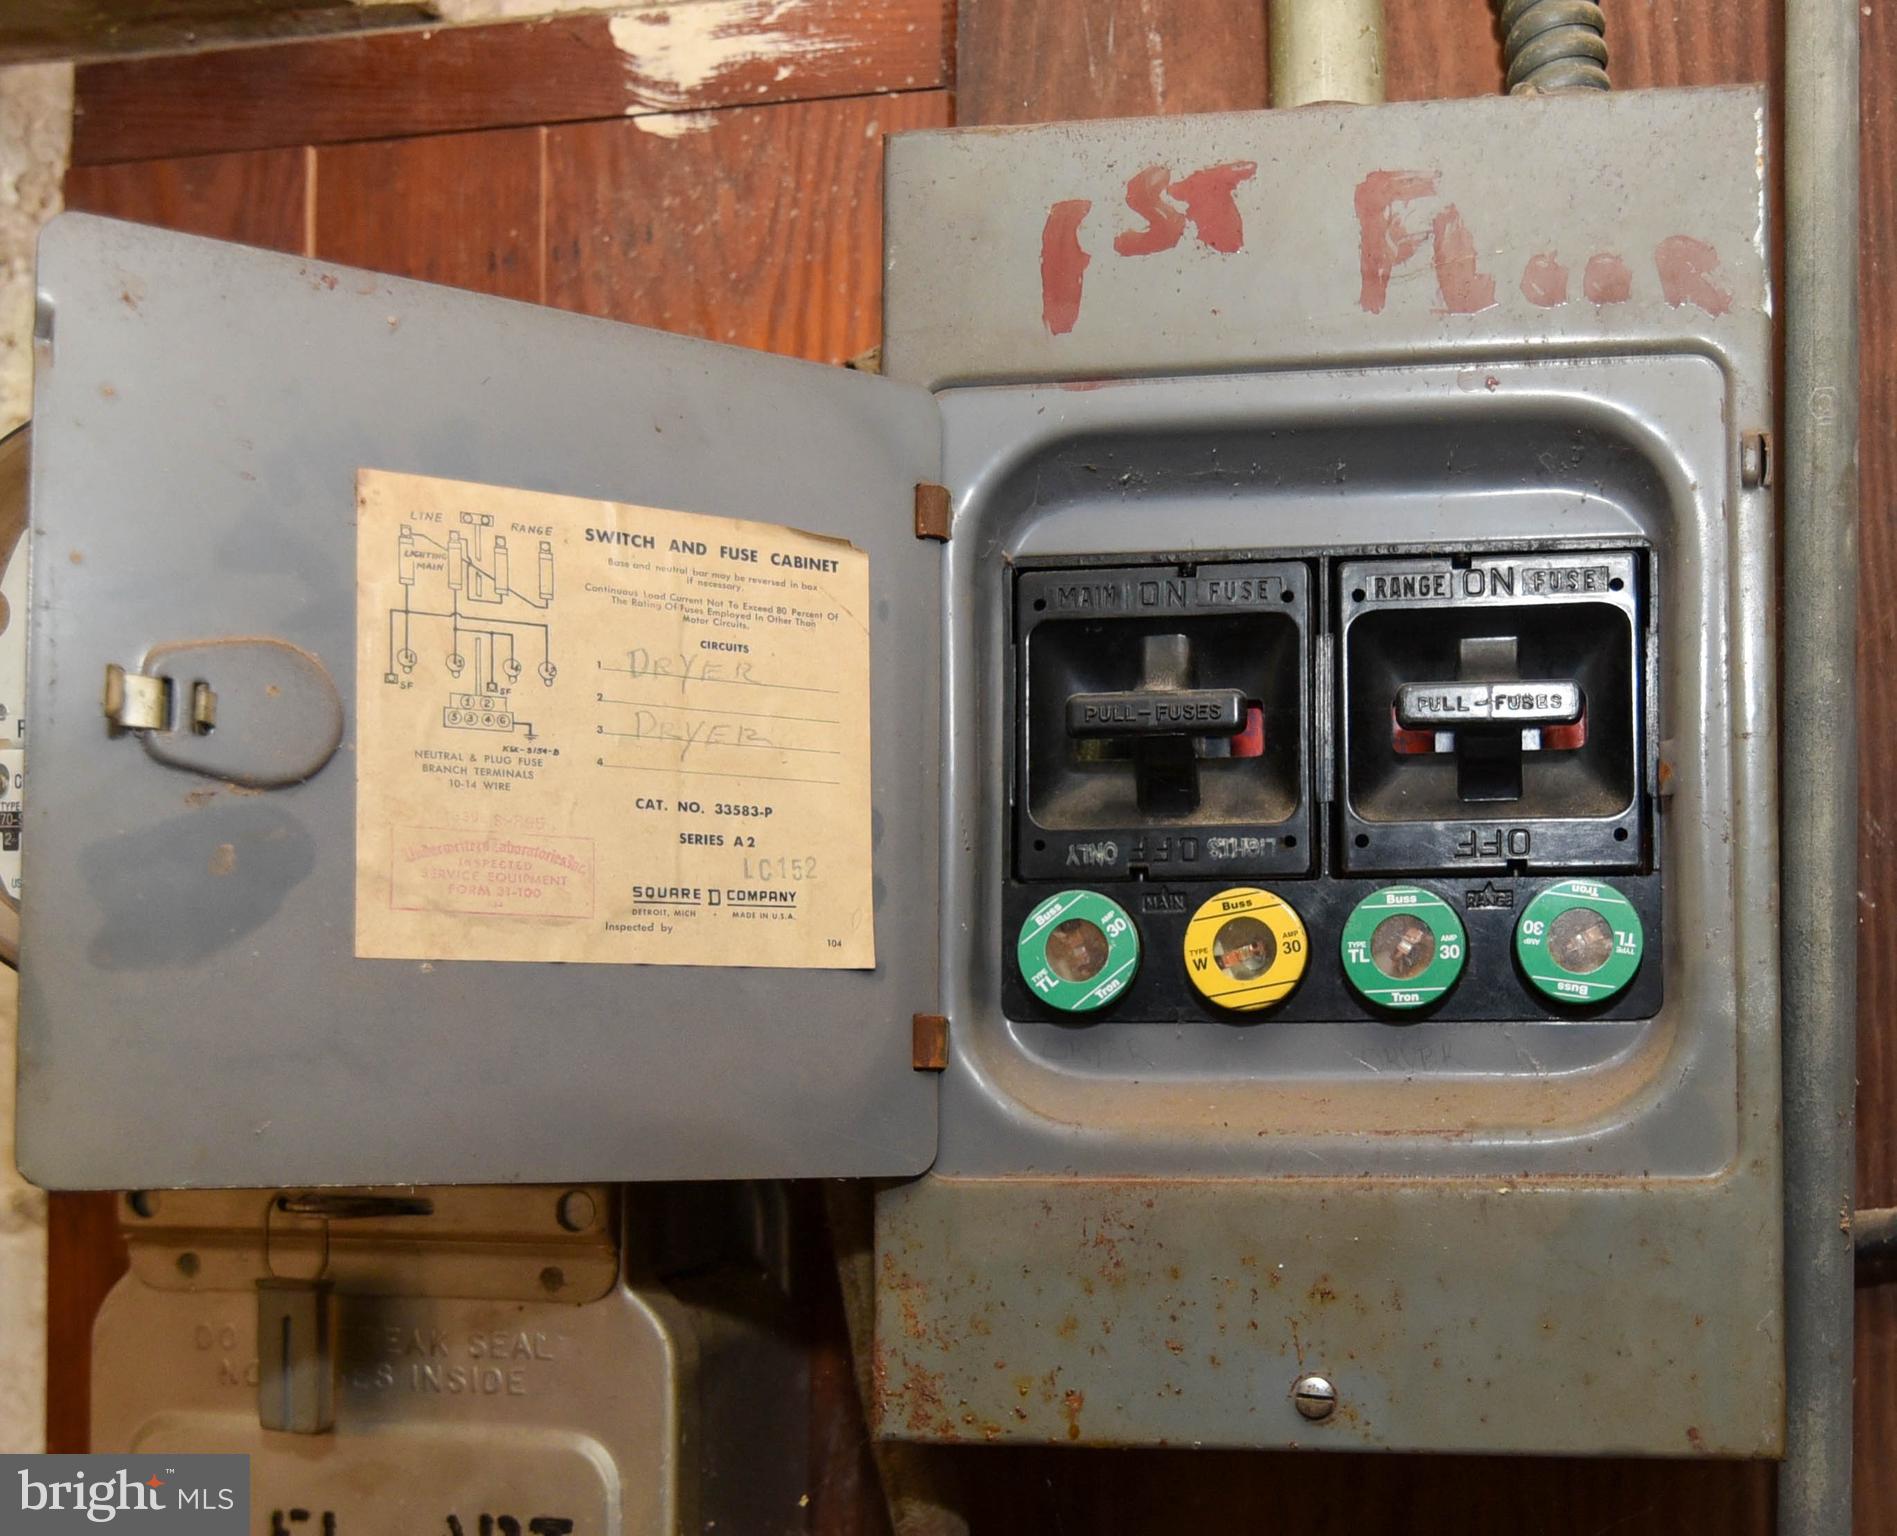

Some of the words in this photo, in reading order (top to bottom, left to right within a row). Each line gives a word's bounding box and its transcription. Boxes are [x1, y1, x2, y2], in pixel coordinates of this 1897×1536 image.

[410, 511, 443, 523] LINE
[511, 523, 553, 536] RANGE
[585, 528, 655, 549] SWITCH
[670, 539, 707, 555] AND
[720, 546, 758, 562] FUSE
[771, 553, 839, 573] CABINET
[416, 562, 444, 571] MAIN
[608, 558, 630, 568] Base
[633, 562, 651, 571] and
[656, 565, 688, 575] neutral
[693, 568, 709, 578] bar
[711, 571, 731, 582] may
[735, 573, 745, 581] be
[749, 575, 786, 587] reversed
[790, 580, 799, 588] in
[801, 582, 818, 591] box
[1374, 574, 1445, 598] RANGE
[1463, 567, 1515, 596] ON
[1533, 569, 1595, 592] FUSE
[585, 583, 638, 596] Continuous
[644, 590, 666, 600] Load
[670, 593, 703, 605] Current
[707, 598, 723, 608] Not
[728, 600, 739, 609] To
[743, 602, 774, 614] Exceed
[776, 606, 787, 615] 80
[792, 608, 823, 619] Percent
[827, 612, 838, 621] Of
[1058, 583, 1117, 609] MAIN
[1139, 580, 1187, 607] ON
[1208, 580, 1268, 601] FUSE
[611, 596, 627, 605] The
[631, 598, 662, 611] Rating
[665, 602, 677, 611] Of
[680, 604, 704, 615] Fuses
[707, 608, 751, 621] Employed
[755, 614, 764, 622] In
[767, 615, 792, 625] Other
[796, 618, 816, 628] Than
[683, 614, 708, 625] Motor
[713, 618, 749, 630] Circuits.
[700, 640, 749, 654] CIRCUITS
[627, 647, 762, 695] DRYER
[400, 681, 414, 690] SF
[500, 687, 512, 696] SF
[597, 692, 603, 702] 2
[1085, 703, 1222, 722] PULL-FUSES
[597, 725, 603, 734] 3
[635, 711, 772, 762] DRYER
[415, 750, 464, 762] NEUTRAL
[469, 753, 477, 762] &
[484, 754, 512, 765] PLUG
[518, 757, 544, 767] FUSE
[597, 757, 603, 766] 4
[422, 764, 468, 775] BRANCH
[474, 768, 535, 780] TERMINALS
[449, 780, 477, 789] 10-14
[483, 781, 511, 791] WIRE
[1, 802, 20, 812] TYPE
[635, 798, 668, 812] CAT.
[677, 801, 705, 814] NO.
[715, 803, 773, 818] 33583-P
[679, 833, 724, 846] SERIES
[1454, 828, 1531, 858] OFF
[1065, 841, 1119, 866] ONLY
[1128, 836, 1199, 862] OFF
[488, 871, 568, 885] EQUIPMENT
[448, 883, 491, 896] FORM
[632, 886, 701, 900] SQUARE
[708, 889, 721, 906] D
[727, 890, 797, 903] COMPANY
[1571, 884, 1600, 897] Tron
[1222, 898, 1253, 911] Buss
[1386, 894, 1417, 905] Buss
[732, 911, 756, 919] MADE
[759, 911, 768, 919] IN
[772, 912, 797, 920] U.S.A.
[1035, 903, 1063, 927] Buss
[1101, 910, 1116, 925] AMP
[605, 921, 654, 934] Inspected
[661, 923, 673, 934] by
[1106, 917, 1127, 938] 30
[1281, 930, 1299, 939] AMP
[1523, 920, 1545, 935] 30
[826, 938, 842, 948] 104
[1440, 934, 1458, 942] AMP
[1523, 938, 1542, 946] AMP
[1614, 931, 1636, 947] TL
[1188, 947, 1209, 956] TYPE
[1282, 939, 1301, 955] 30
[1439, 945, 1460, 960] 30
[1615, 947, 1636, 955] TYPE
[1348, 949, 1370, 963] TL
[1193, 958, 1209, 972] W
[1035, 973, 1060, 994] TL
[1094, 979, 1121, 1000] Tron
[1557, 981, 1589, 995] Buss
[1391, 992, 1419, 1003] Tron
[467, 1330, 553, 1361] SEAL
[411, 1363, 527, 1395] INSIDE
